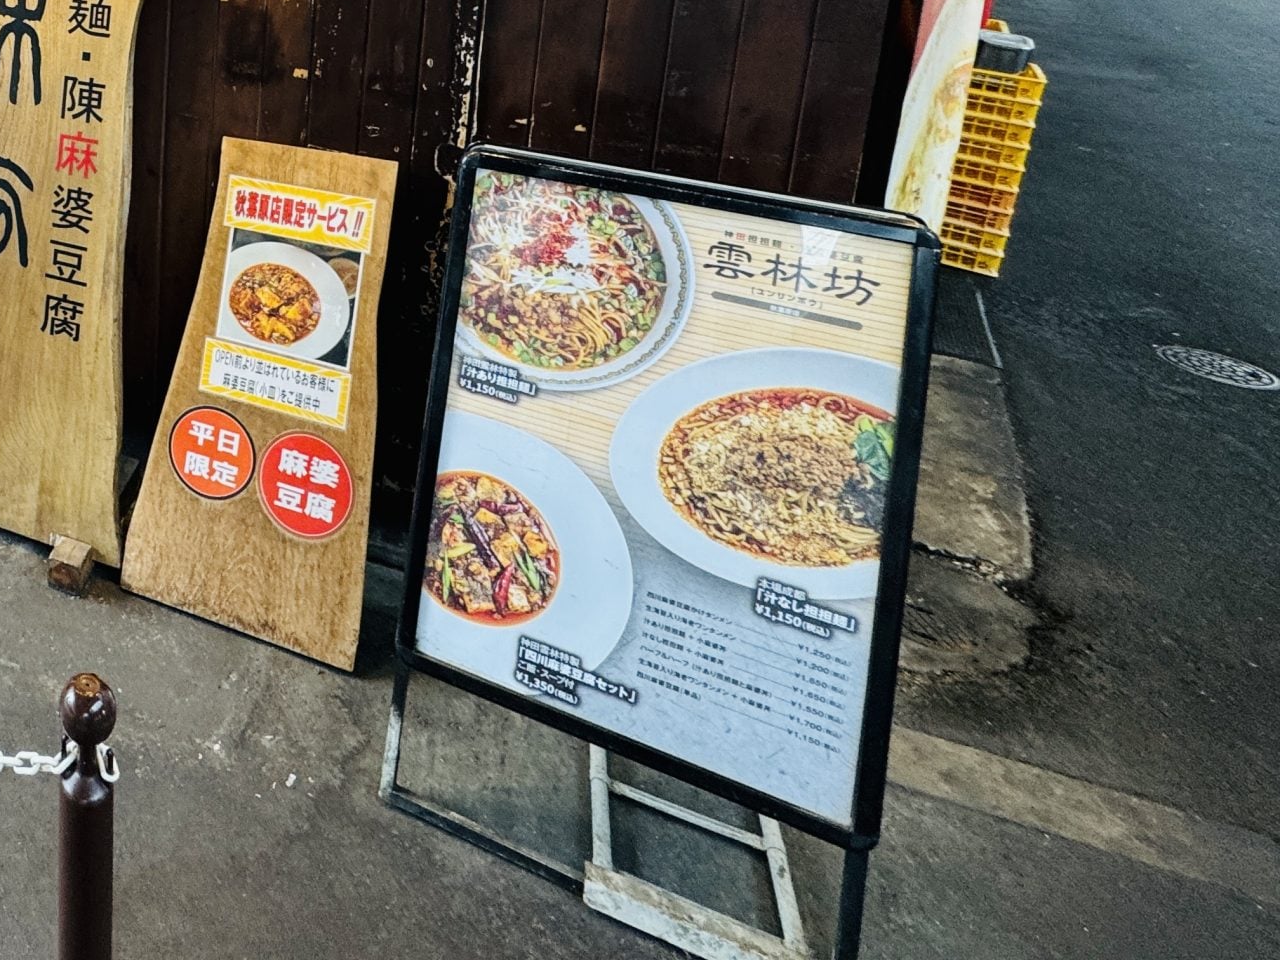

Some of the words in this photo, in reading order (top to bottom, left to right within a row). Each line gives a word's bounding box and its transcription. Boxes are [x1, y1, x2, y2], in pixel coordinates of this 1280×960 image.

[703, 241, 881, 306] 雲林坊
[188, 420, 241, 457] 平日
[184, 451, 239, 488] 限定
[278, 448, 341, 488] 麻婆
[273, 481, 337, 524] 豆腐
[519, 646, 636, 703] 「四川麻婆豆腐セット」
